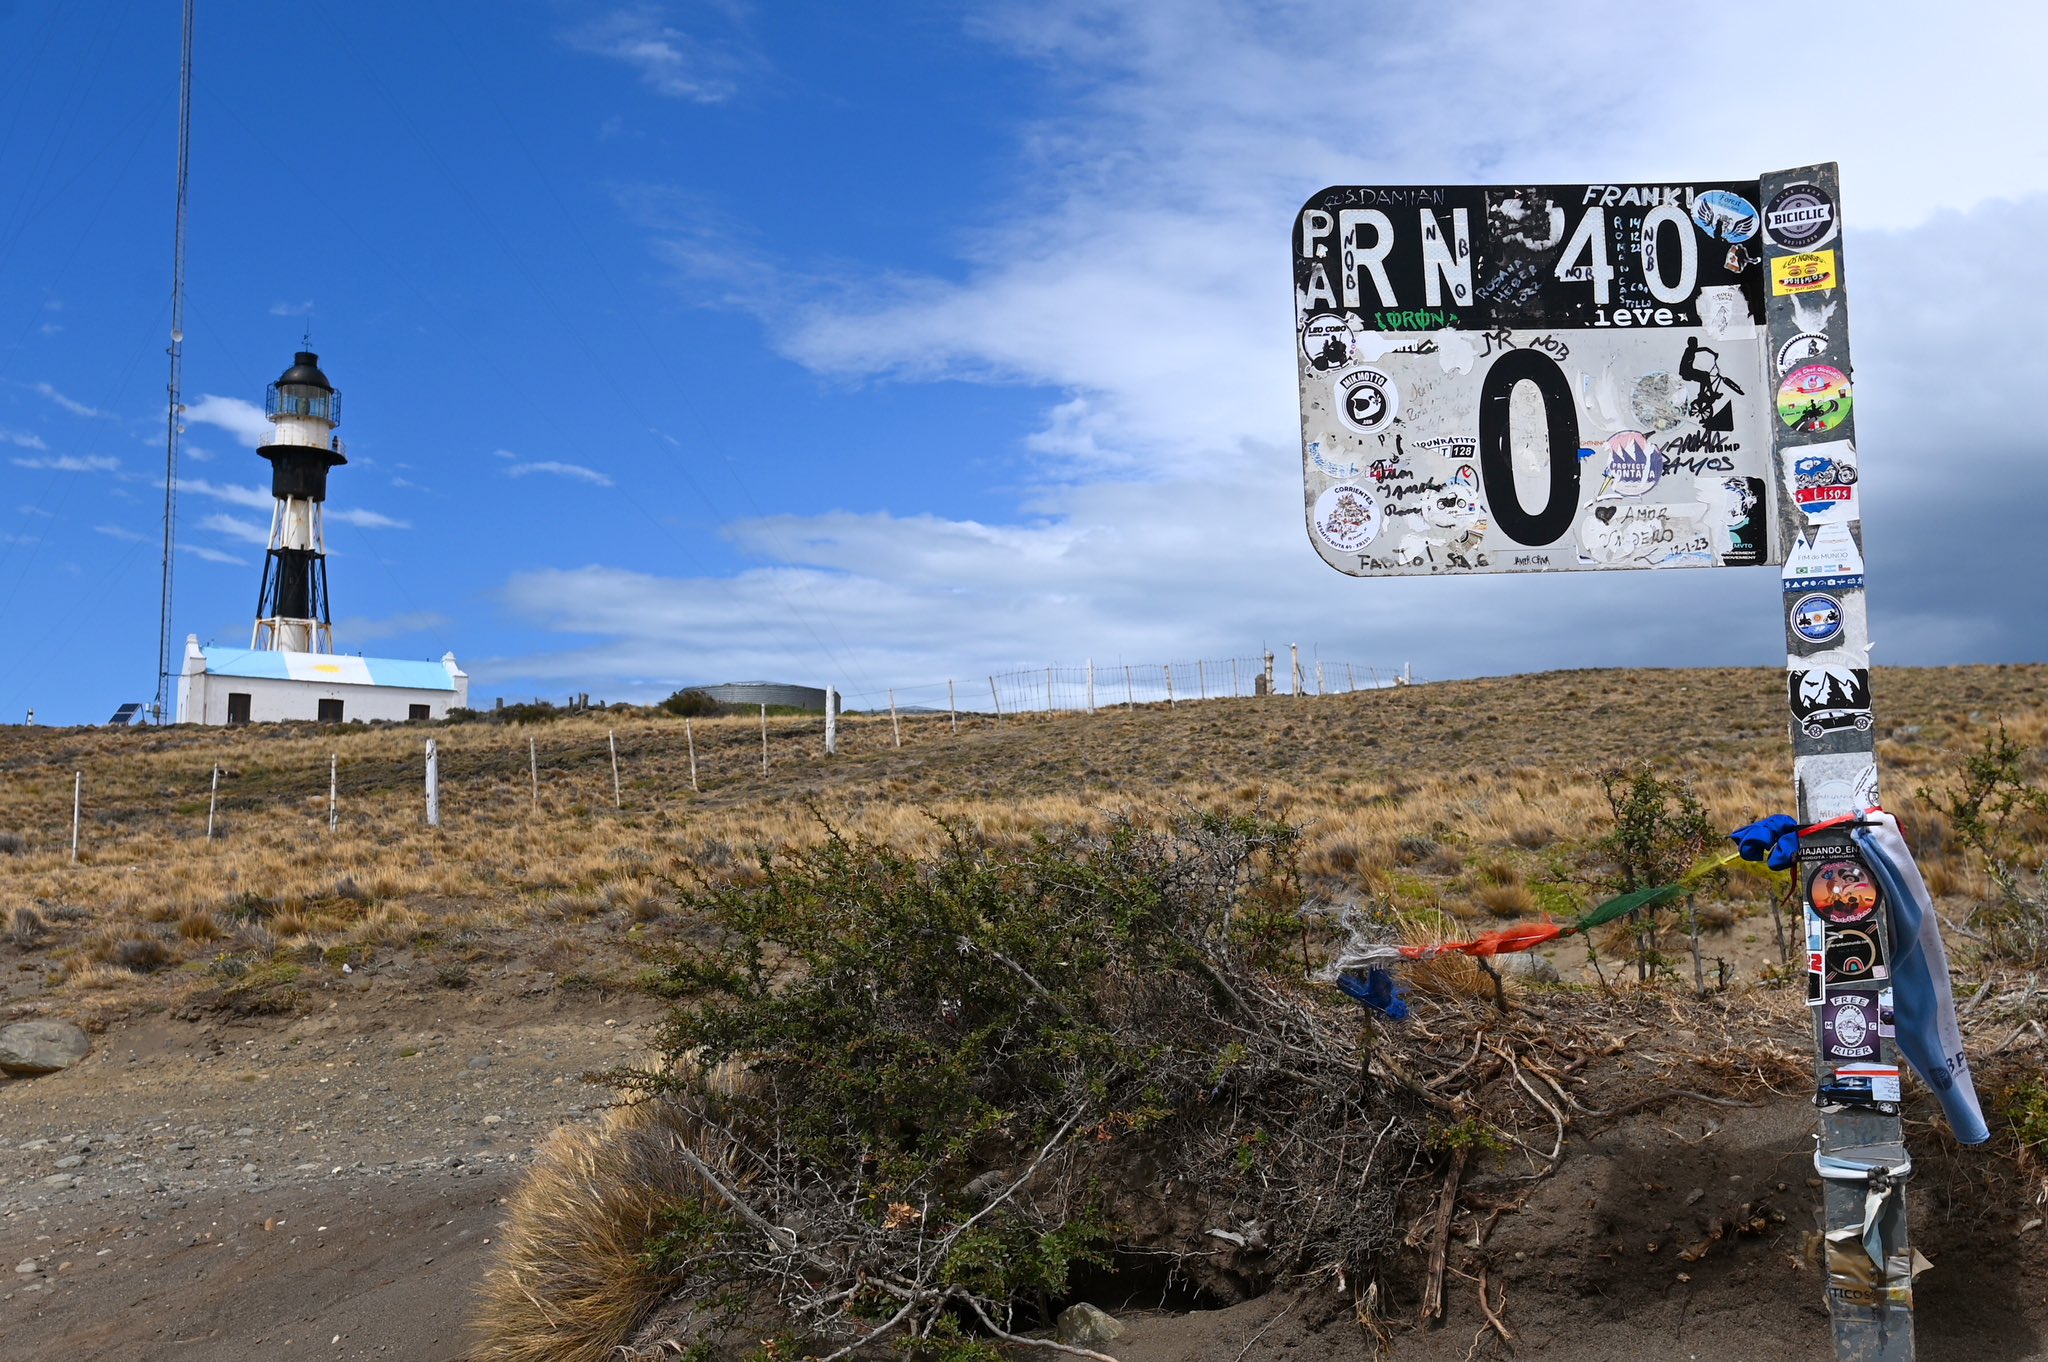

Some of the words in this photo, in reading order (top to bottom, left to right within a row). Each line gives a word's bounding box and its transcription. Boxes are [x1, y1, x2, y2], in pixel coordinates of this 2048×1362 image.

[1774, 208, 1825, 225] BICICLIC
[1554, 205, 1698, 304] 40
[1565, 268, 1594, 279] NOB
[1341, 371, 1387, 389] MIKMOTTO
[1453, 446, 1473, 456] 128
[1479, 347, 1578, 546] 0
[1334, 486, 1374, 506] CORRIENTES
[1814, 488, 1848, 500] Lisos
[1820, 551, 1848, 560] MUNDO
[1834, 996, 1866, 1006] FREE
[1833, 1046, 1869, 1056] RIDER
